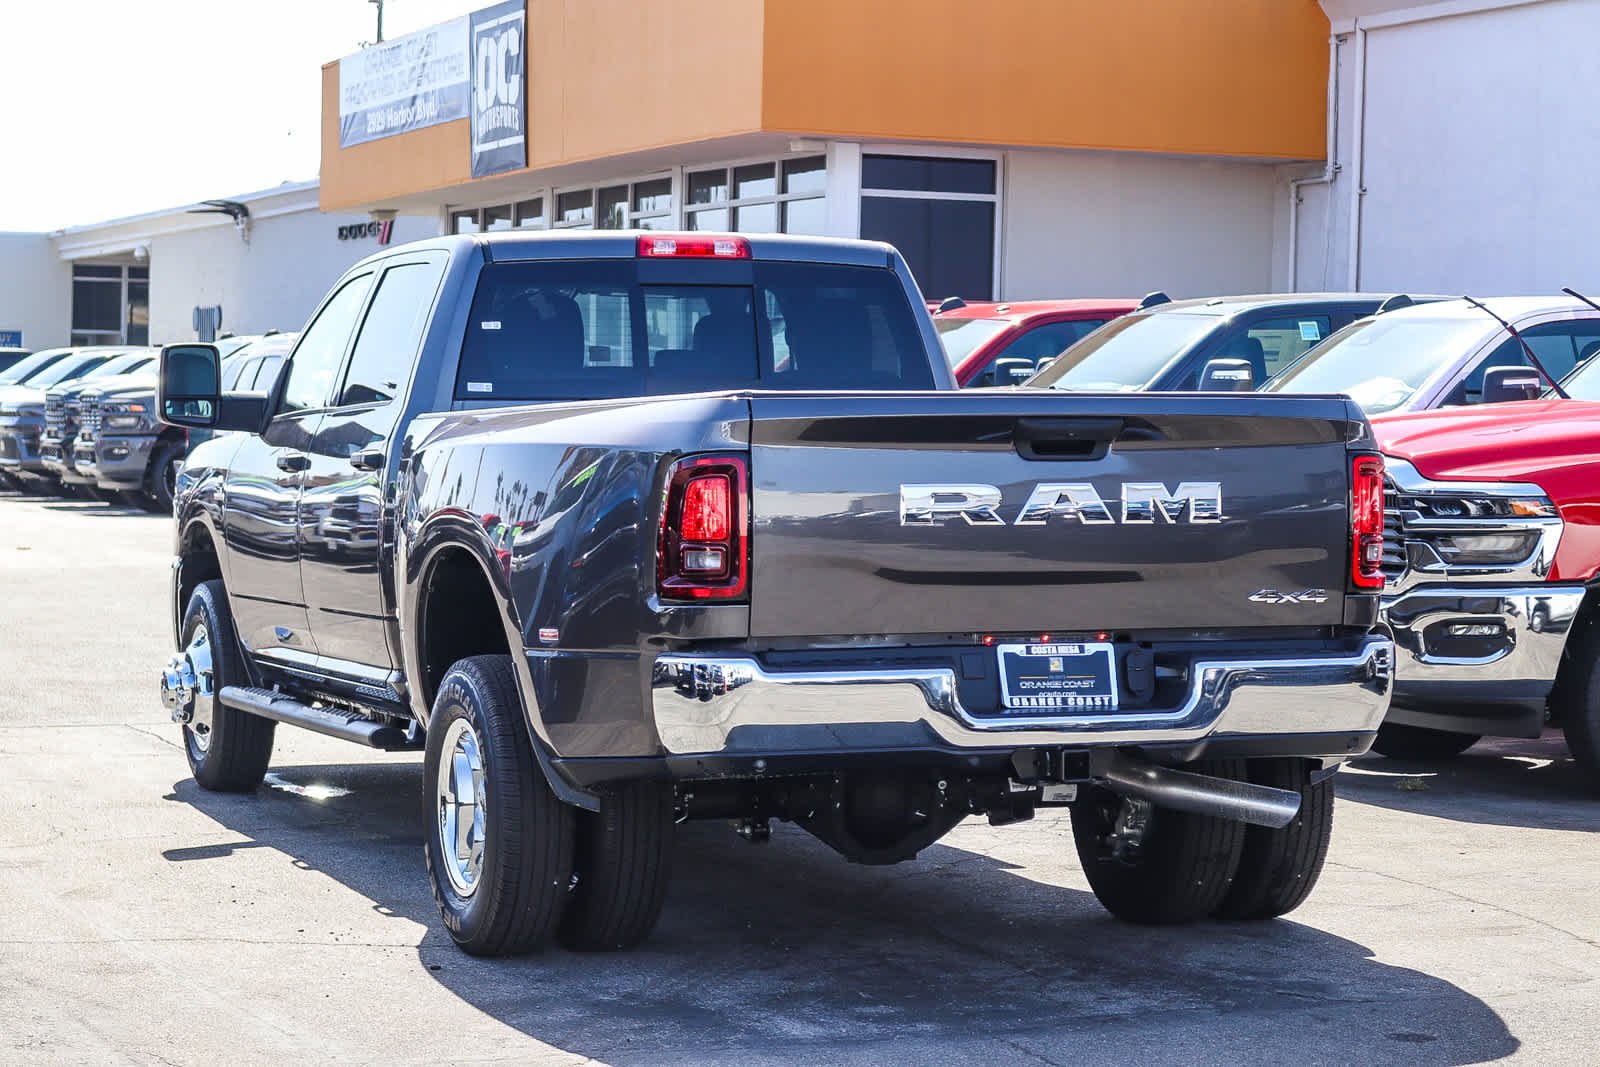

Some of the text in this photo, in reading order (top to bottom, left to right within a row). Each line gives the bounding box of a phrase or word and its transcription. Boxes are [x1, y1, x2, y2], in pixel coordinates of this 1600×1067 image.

[477, 26, 520, 113] OC
[900, 482, 1222, 526] RAM
[1247, 588, 1329, 603] 4x4
[1031, 645, 1080, 655] COSTA MESA
[1019, 680, 1096, 689] ORANGE COAST
[1011, 696, 1110, 706] ORANGE COAST
